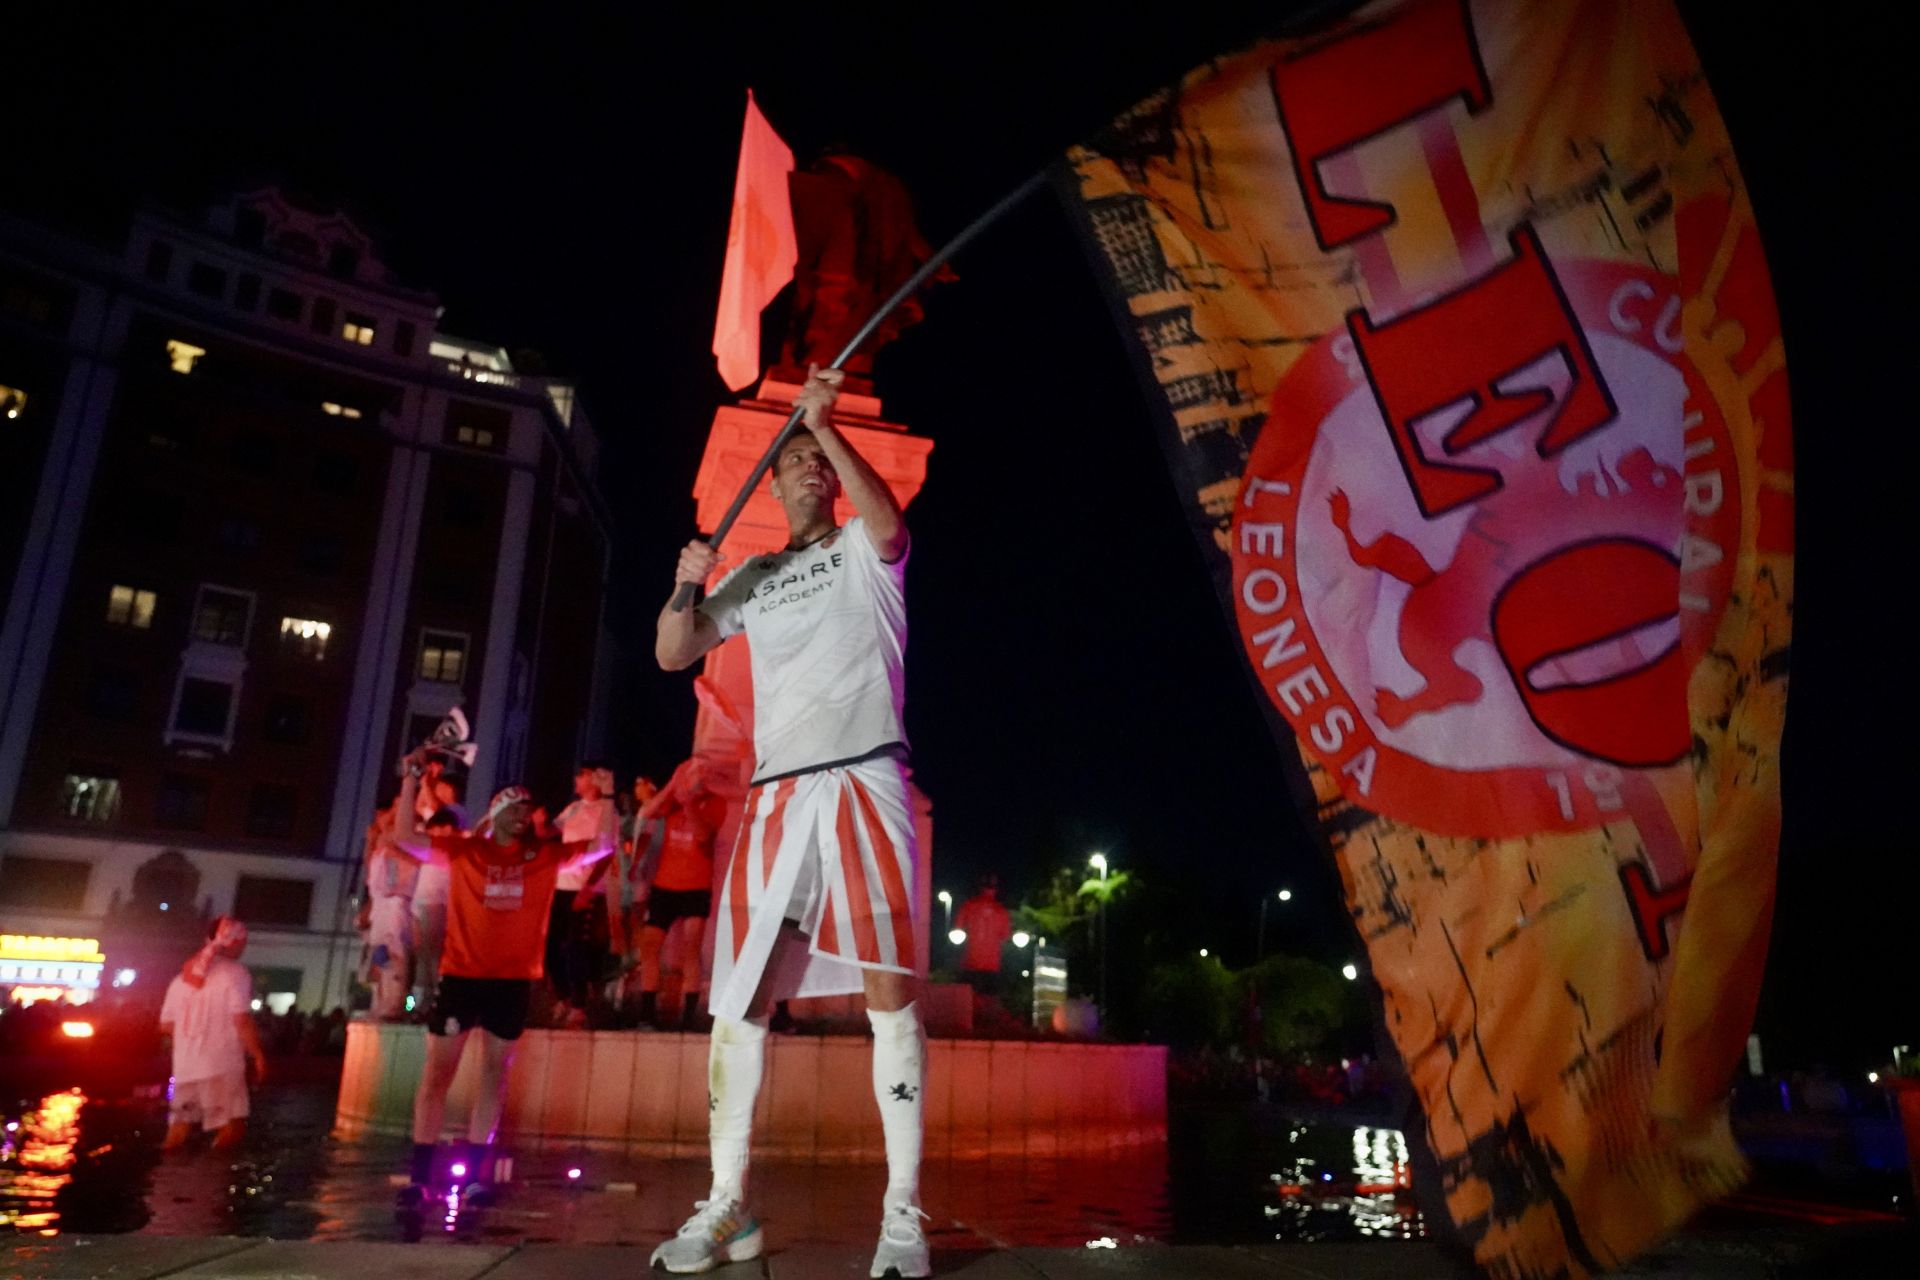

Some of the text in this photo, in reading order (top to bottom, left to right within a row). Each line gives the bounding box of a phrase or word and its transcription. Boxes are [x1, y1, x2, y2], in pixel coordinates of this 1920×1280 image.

[1268, 0, 1694, 962] LEO
[744, 553, 843, 604] ASPIRE
[759, 579, 834, 616] ACADEMY
[1240, 474, 1378, 797] LEONESA
